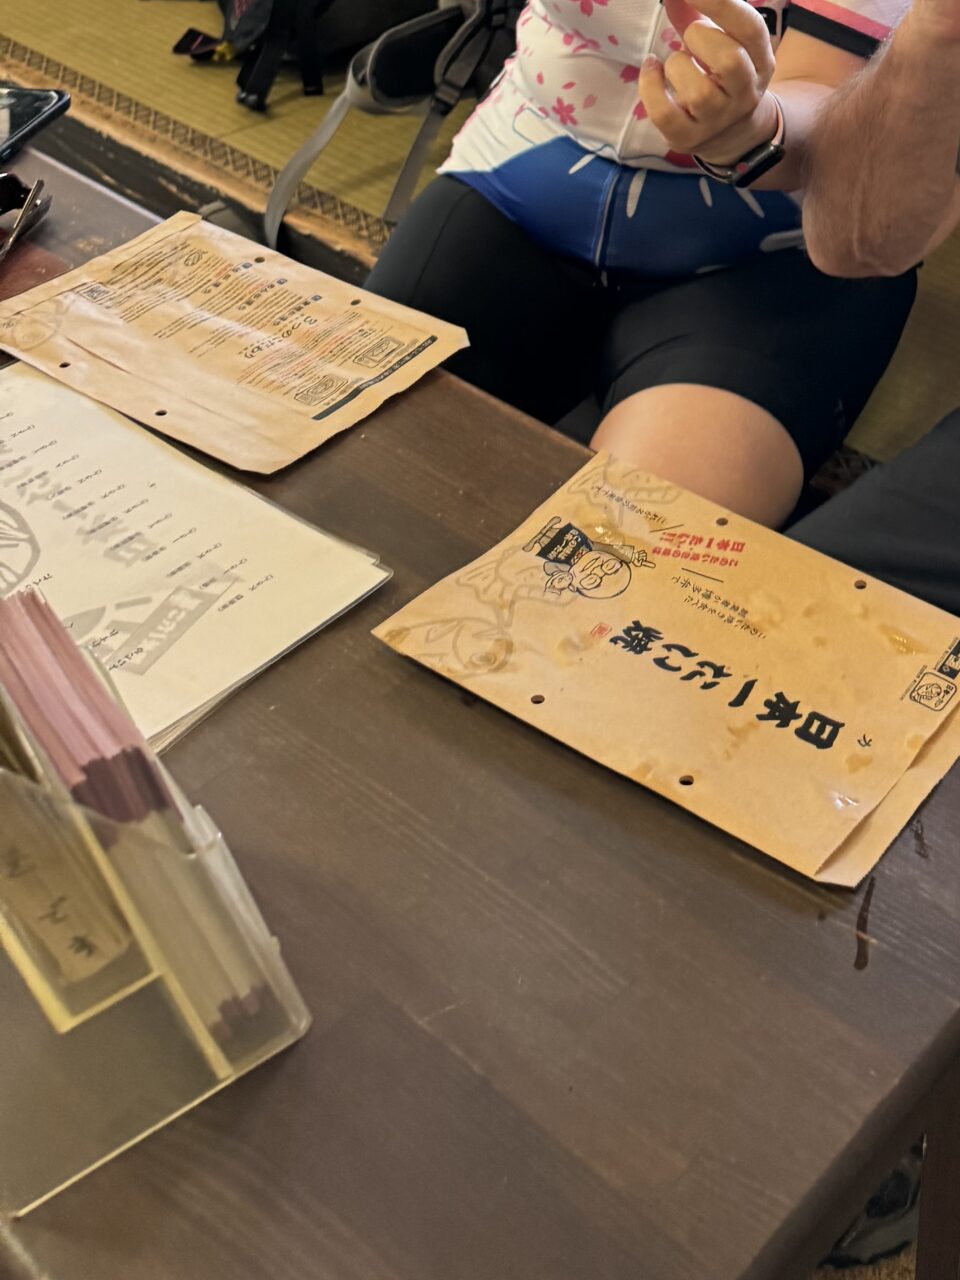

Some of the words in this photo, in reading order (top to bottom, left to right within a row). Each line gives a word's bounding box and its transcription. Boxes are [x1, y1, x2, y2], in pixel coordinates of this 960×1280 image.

[609, 620, 846, 750] 日本一たい焼
